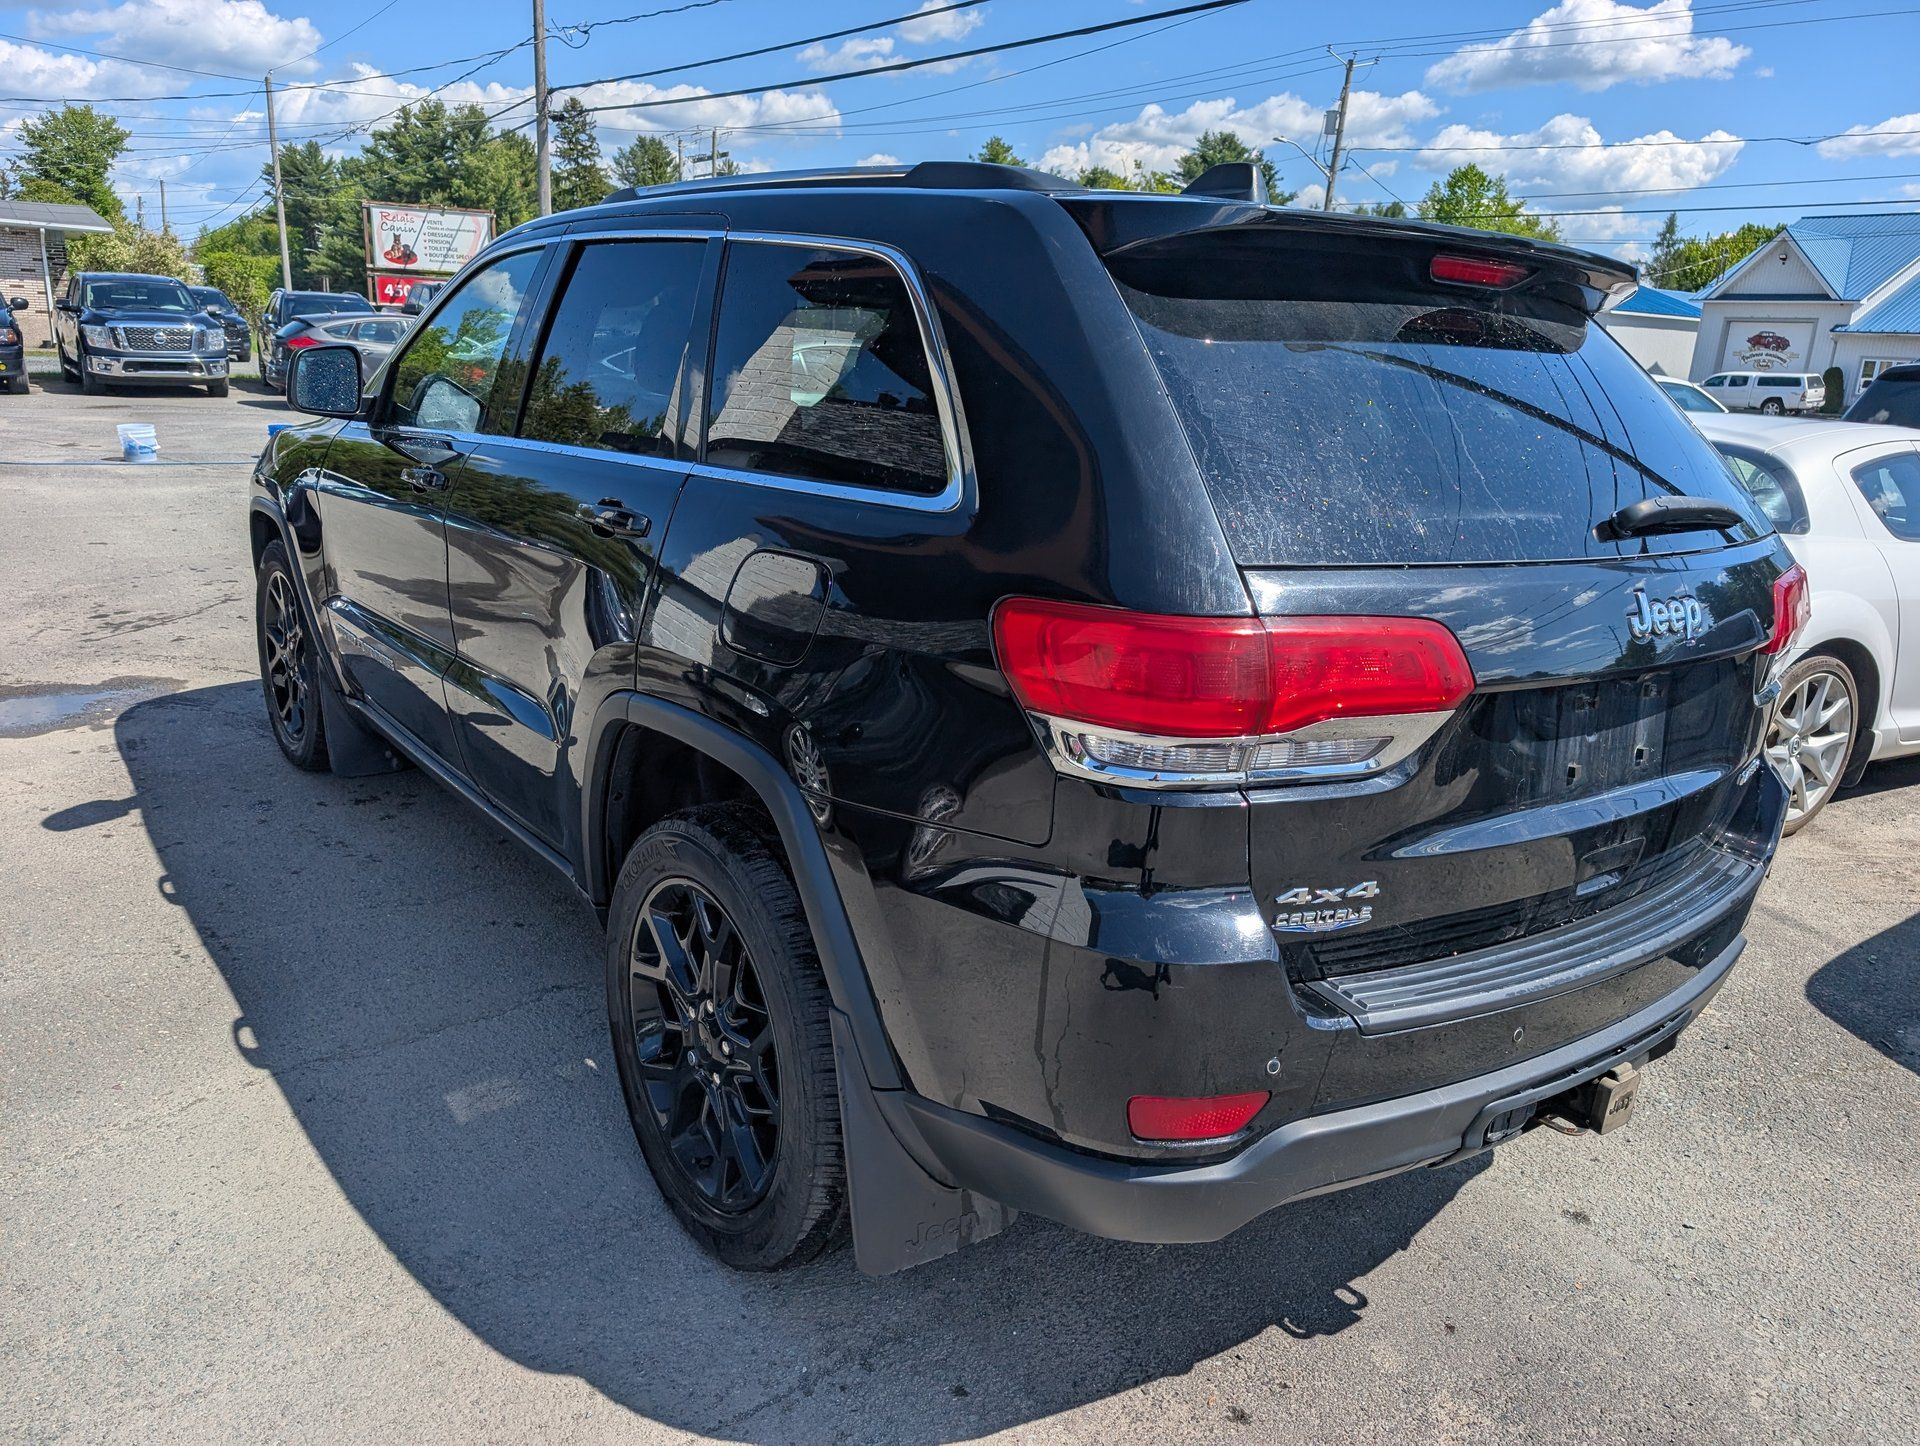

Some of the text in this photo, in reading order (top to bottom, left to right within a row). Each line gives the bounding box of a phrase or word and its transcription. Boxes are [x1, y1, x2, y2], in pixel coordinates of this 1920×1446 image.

[379, 211, 415, 224] Relais
[380, 221, 417, 234] Canin
[427, 231, 454, 239] DRESSAGE
[1626, 588, 1702, 643] Jeep
[1275, 880, 1380, 906] 4x4
[1275, 905, 1373, 927] CAPITALE
